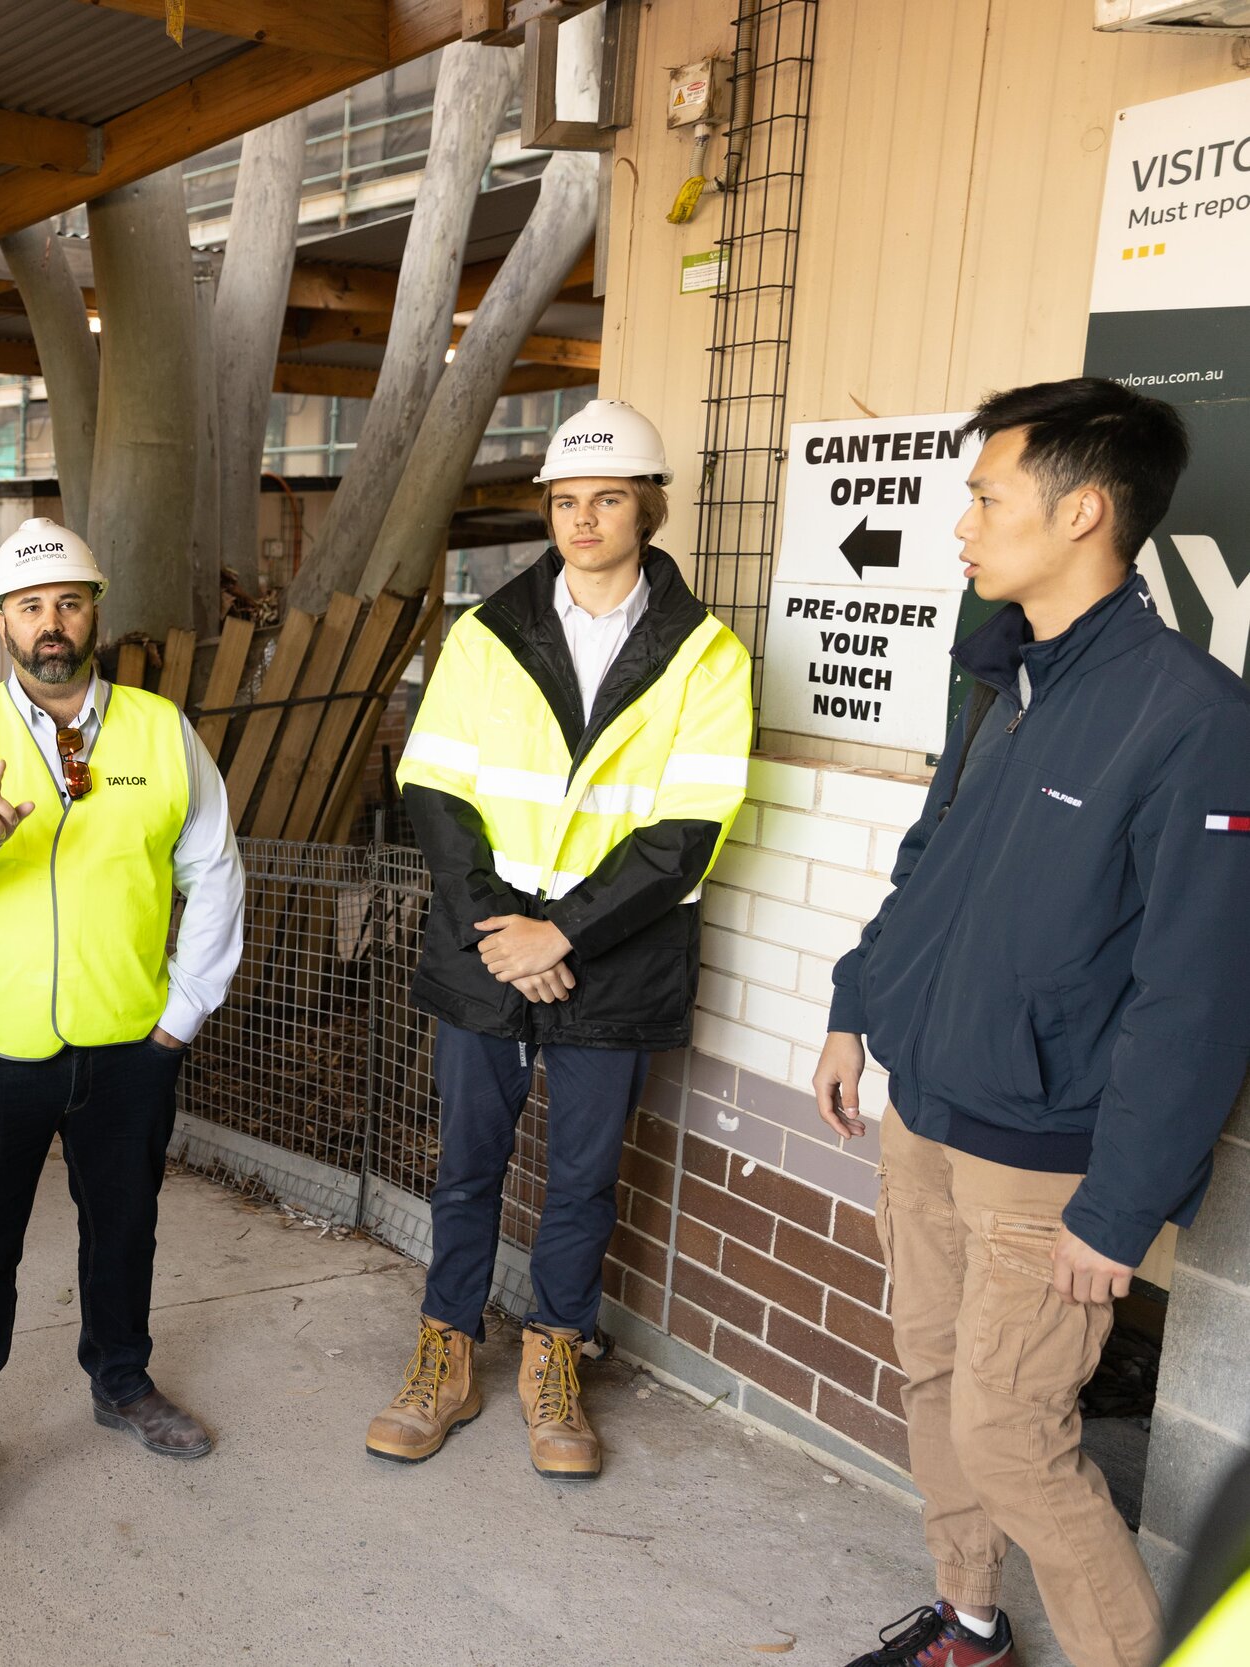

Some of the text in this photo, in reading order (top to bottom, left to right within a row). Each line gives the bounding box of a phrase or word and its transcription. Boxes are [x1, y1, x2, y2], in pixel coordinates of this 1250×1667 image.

[1128, 201, 1188, 229] Must
[1109, 370, 1224, 387] aylorau.com.au
[562, 433, 614, 447] TAYLOR
[805, 429, 965, 465] CANTEEN
[830, 476, 922, 506] OPEN
[15, 542, 64, 558] TAYLOR
[786, 597, 937, 628] PRE-ORDER
[820, 631, 889, 658] YOUR
[808, 662, 892, 692] LUNCH
[812, 694, 882, 723] NOW!
[106, 776, 147, 786] TAYLOR
[1047, 788, 1083, 808] HILFIGER
